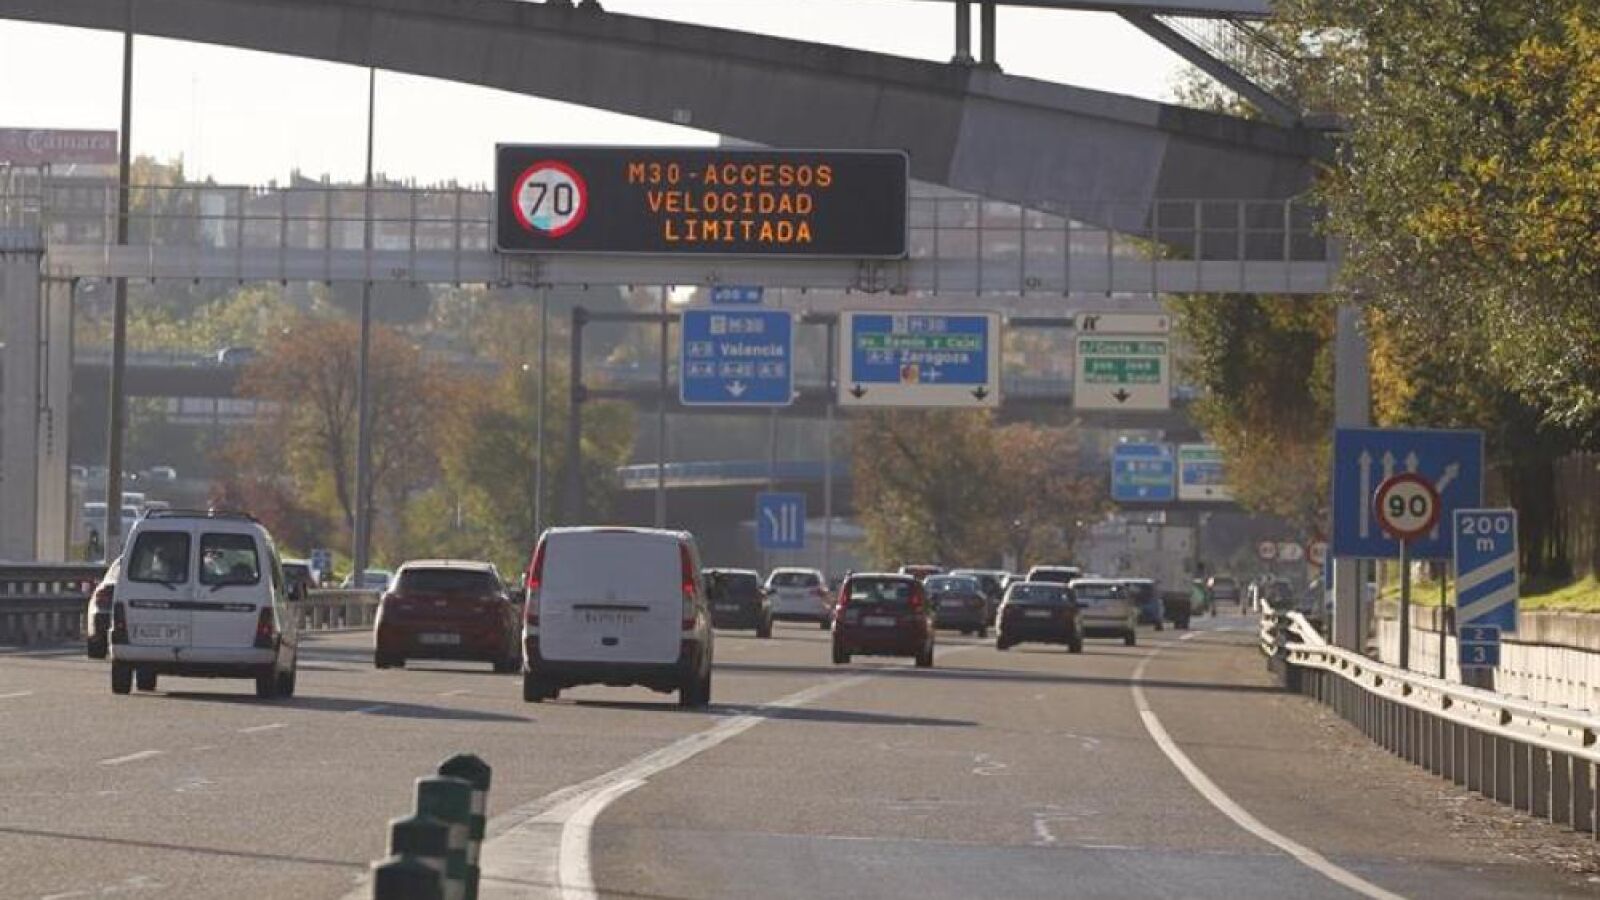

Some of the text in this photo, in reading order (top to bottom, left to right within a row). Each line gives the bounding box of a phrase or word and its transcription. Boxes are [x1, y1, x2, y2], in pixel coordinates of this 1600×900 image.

[528, 182, 573, 216] 70
[647, 192, 814, 214] VELOCIDAD
[664, 219, 812, 243] LIMITADA
[721, 342, 784, 357] Valencia
[900, 350, 970, 366] Zaragoza
[1389, 494, 1426, 518] 90
[1461, 516, 1509, 534] 200
[1476, 537, 1494, 551] m
[1474, 646, 1486, 663] 3
